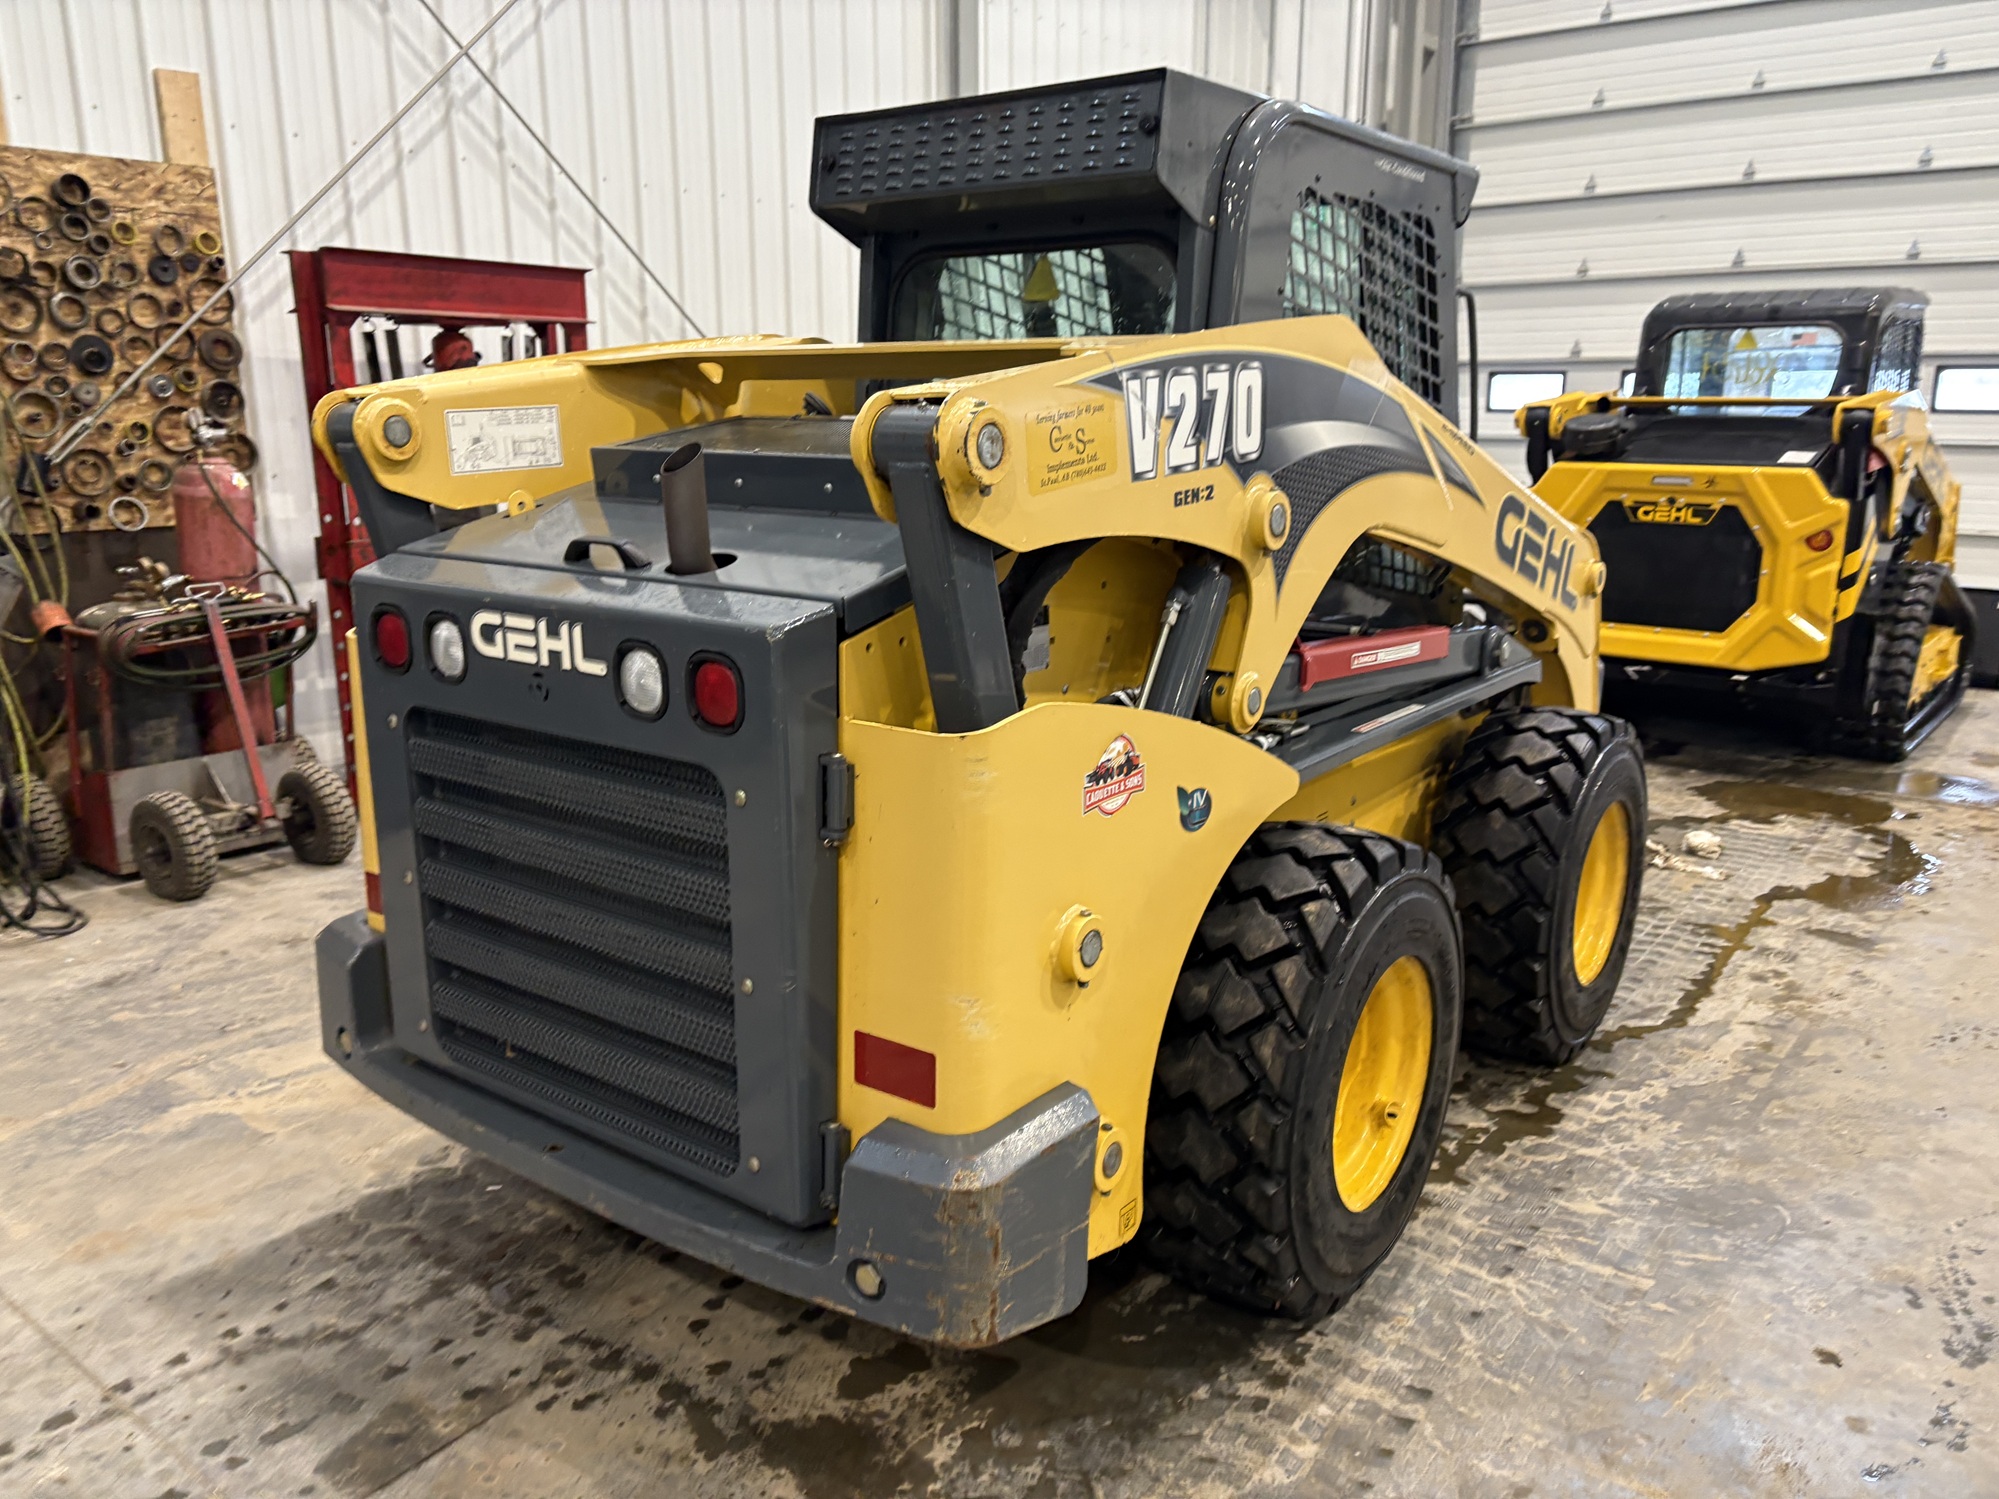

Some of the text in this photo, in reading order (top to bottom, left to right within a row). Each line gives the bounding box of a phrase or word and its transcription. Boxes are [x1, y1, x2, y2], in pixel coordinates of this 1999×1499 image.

[1122, 360, 1263, 483] V270
[1636, 504, 1703, 524] GEHL
[1495, 490, 1578, 613] GEHL
[469, 608, 608, 677] GEHL
[1125, 772, 1143, 790] SONS
